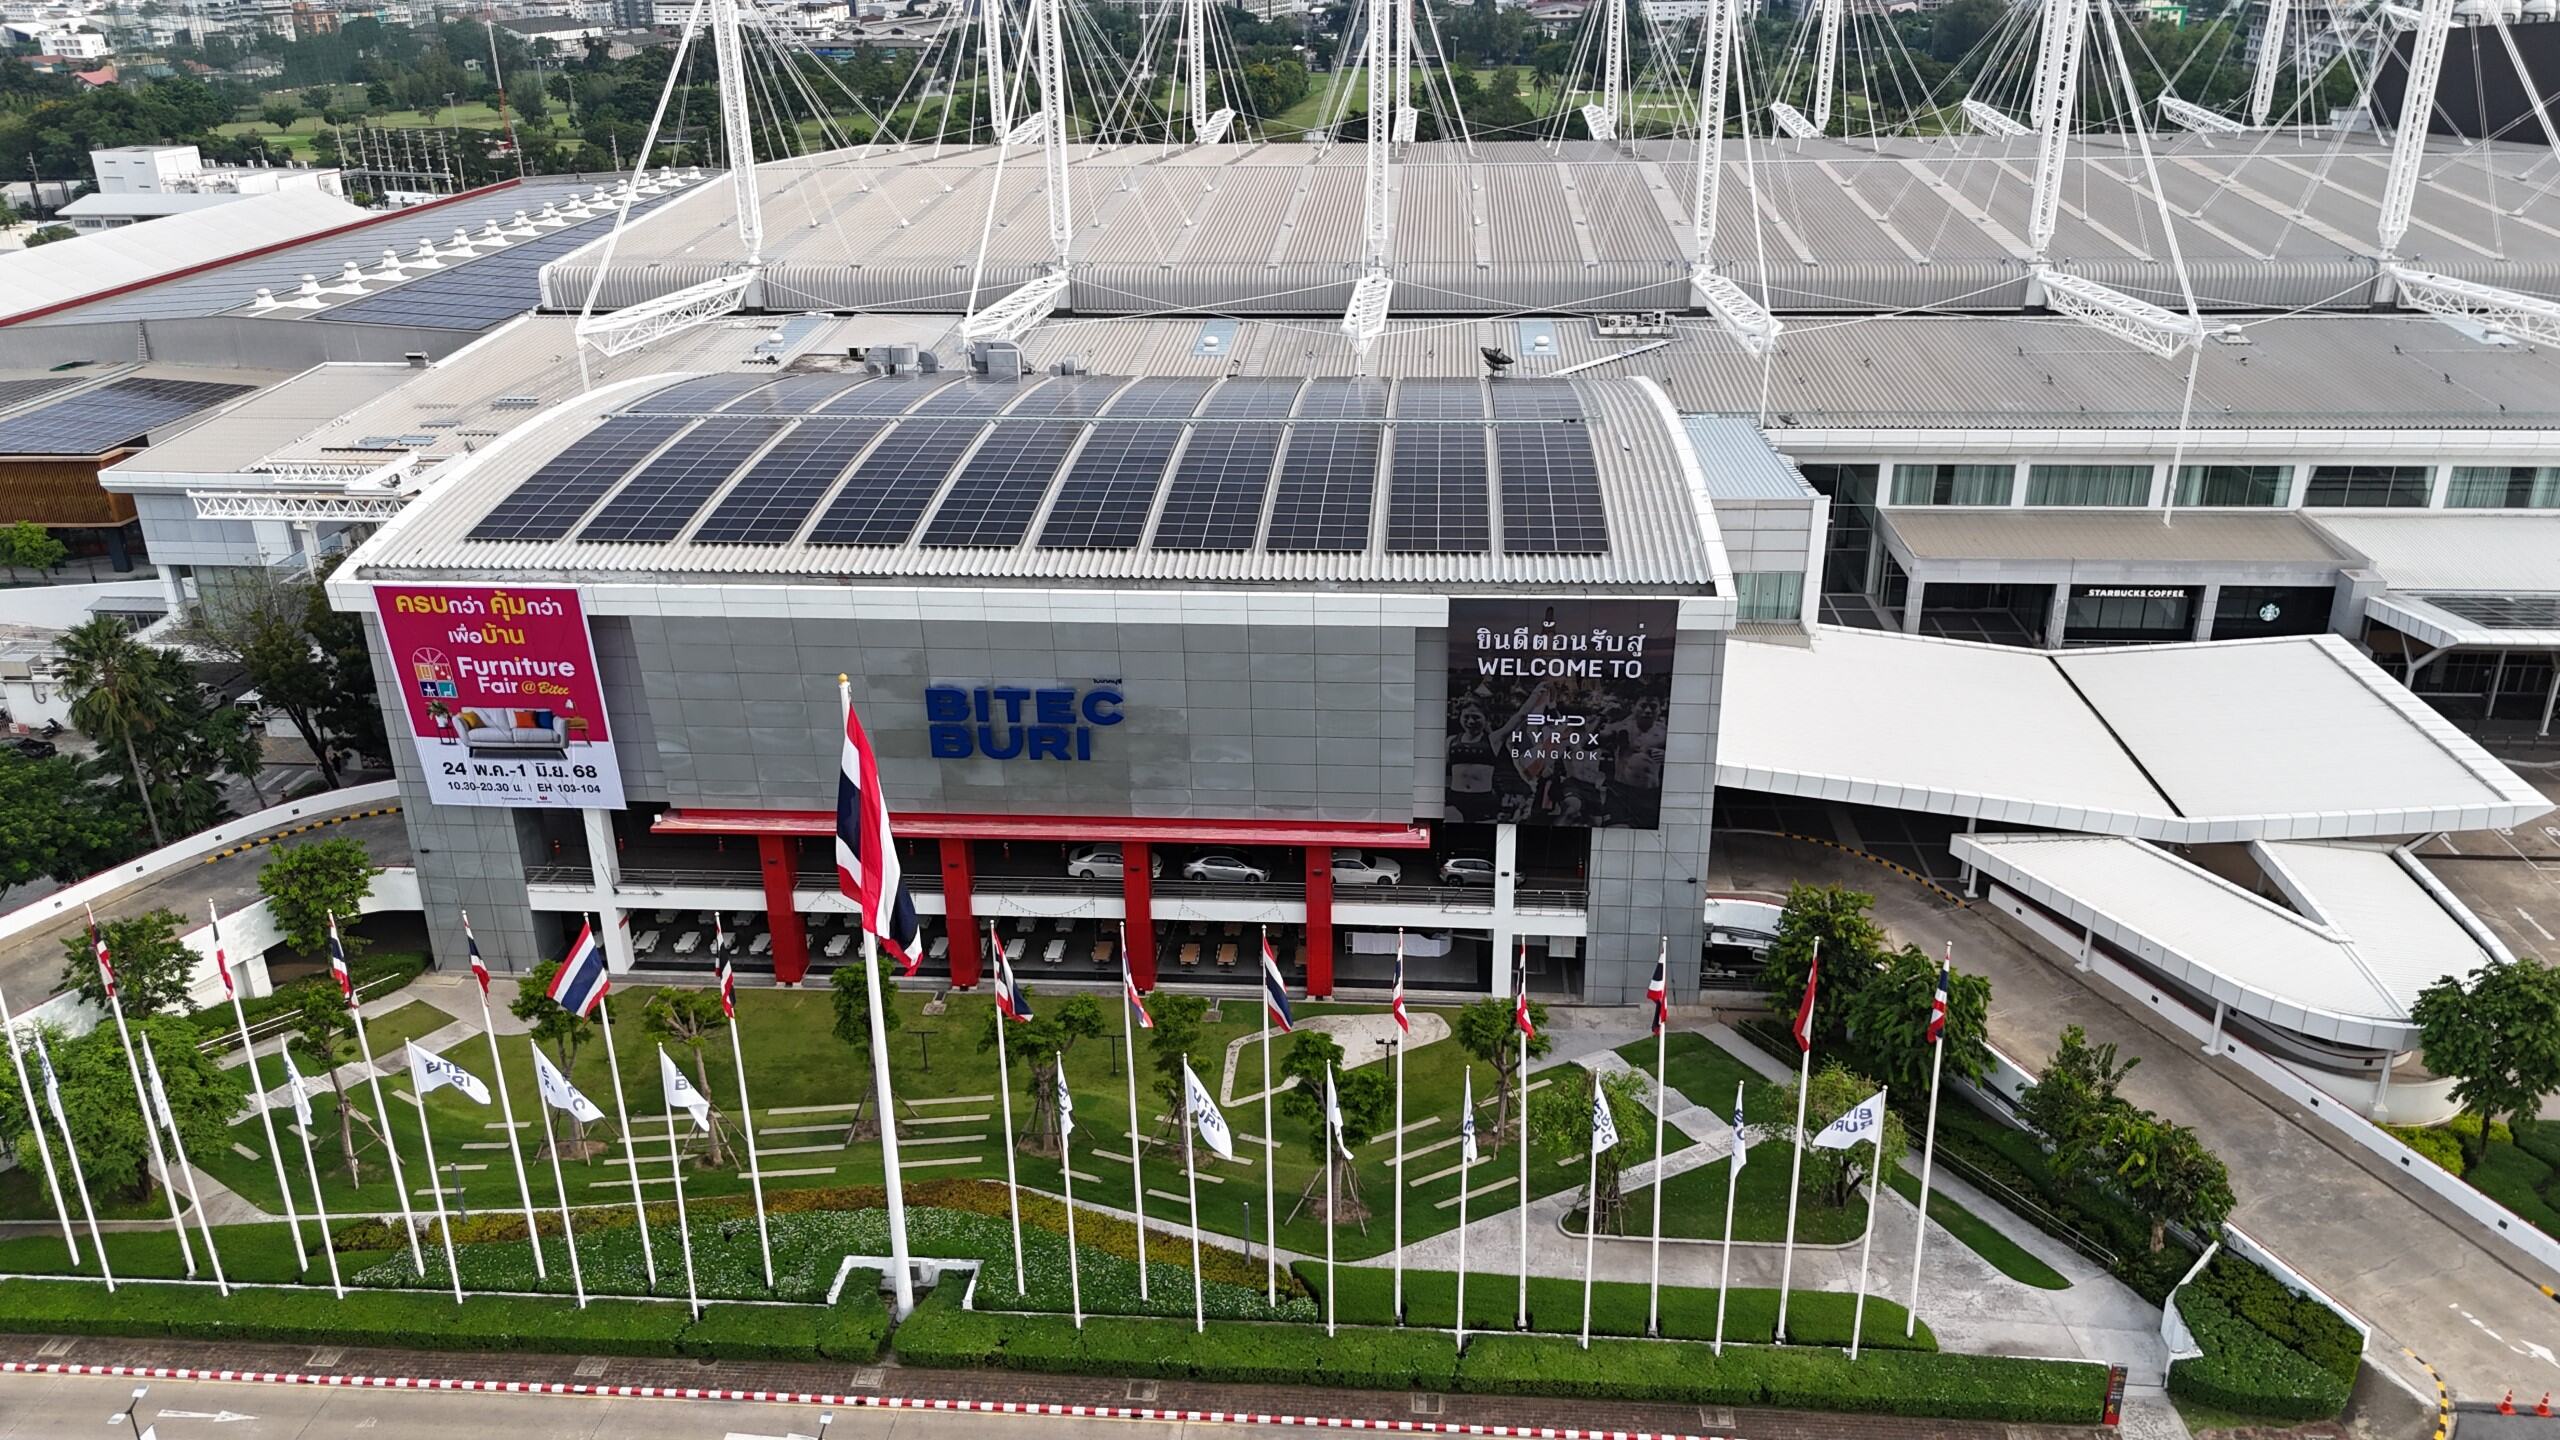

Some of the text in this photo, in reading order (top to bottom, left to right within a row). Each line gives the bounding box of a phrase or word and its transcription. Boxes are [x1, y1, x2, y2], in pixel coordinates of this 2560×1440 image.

[2088, 588, 2185, 598] STARBUCKS COFFEE
[395, 590, 563, 622] ครบกว่า คุ้มกว่า
[448, 622, 526, 646] เพื่อบ้าน
[1476, 621, 1647, 657] ยินดีต้อนรับสู่
[456, 656, 576, 679] Furniture
[1477, 657, 1642, 679] WELCOME TO
[477, 676, 518, 695] Fair
[925, 687, 1125, 726] BITEC
[1527, 713, 1586, 727] BYD
[929, 724, 1091, 760] BURI
[1511, 731, 1600, 745] HYROX
[1511, 748, 1599, 761] BANGKOK
[442, 761, 598, 779] 24 พ.ค.-1 มิ.ย. 68
[447, 781, 601, 794] 10.30-20.30 น. EH 103-104
